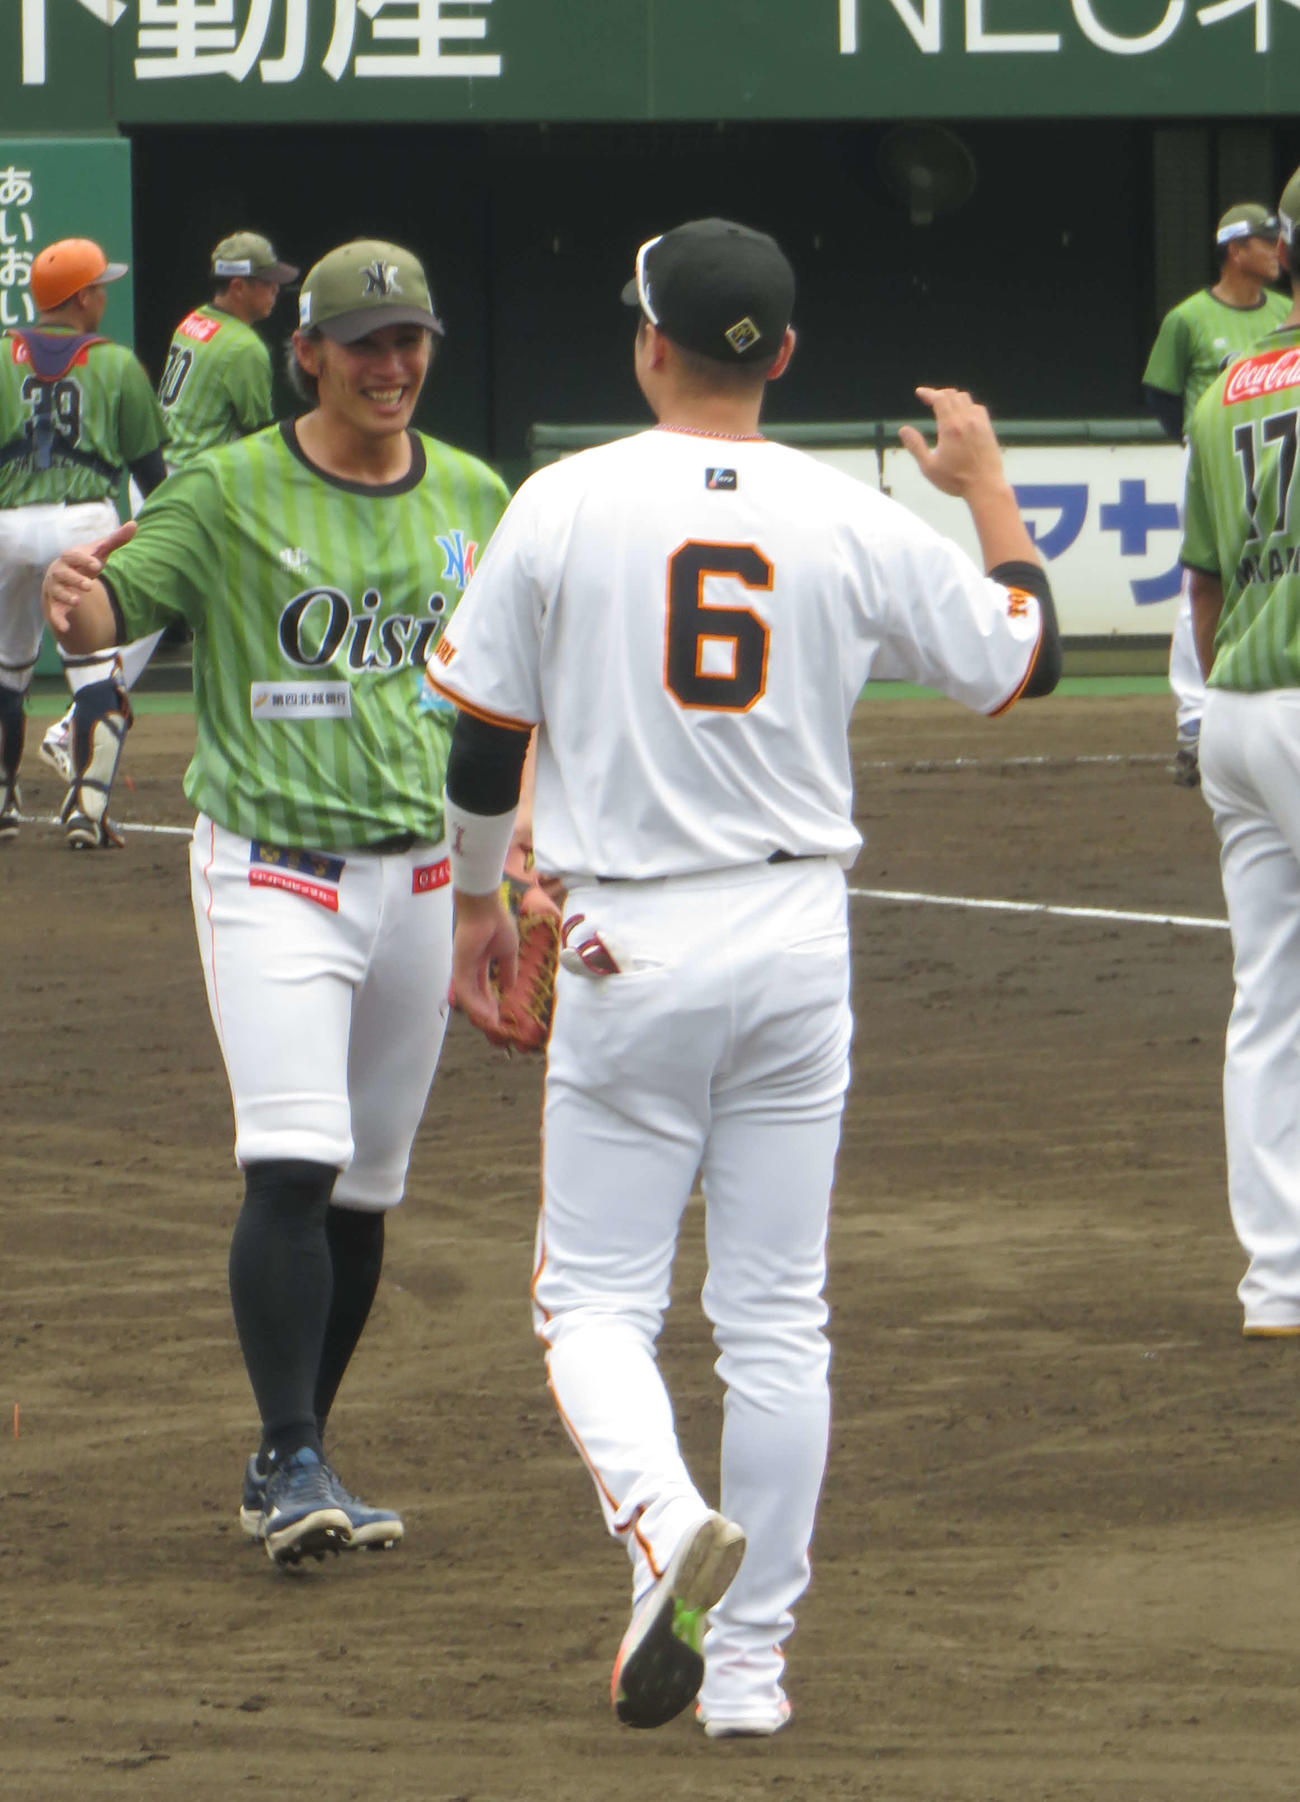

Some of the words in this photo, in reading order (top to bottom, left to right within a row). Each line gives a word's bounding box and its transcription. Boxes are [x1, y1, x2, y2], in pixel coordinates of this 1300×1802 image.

[0, 166, 35, 336] あいおい
[1233, 407, 1300, 545] 17
[278, 585, 447, 675] Oisi
[663, 538, 775, 714] 6
